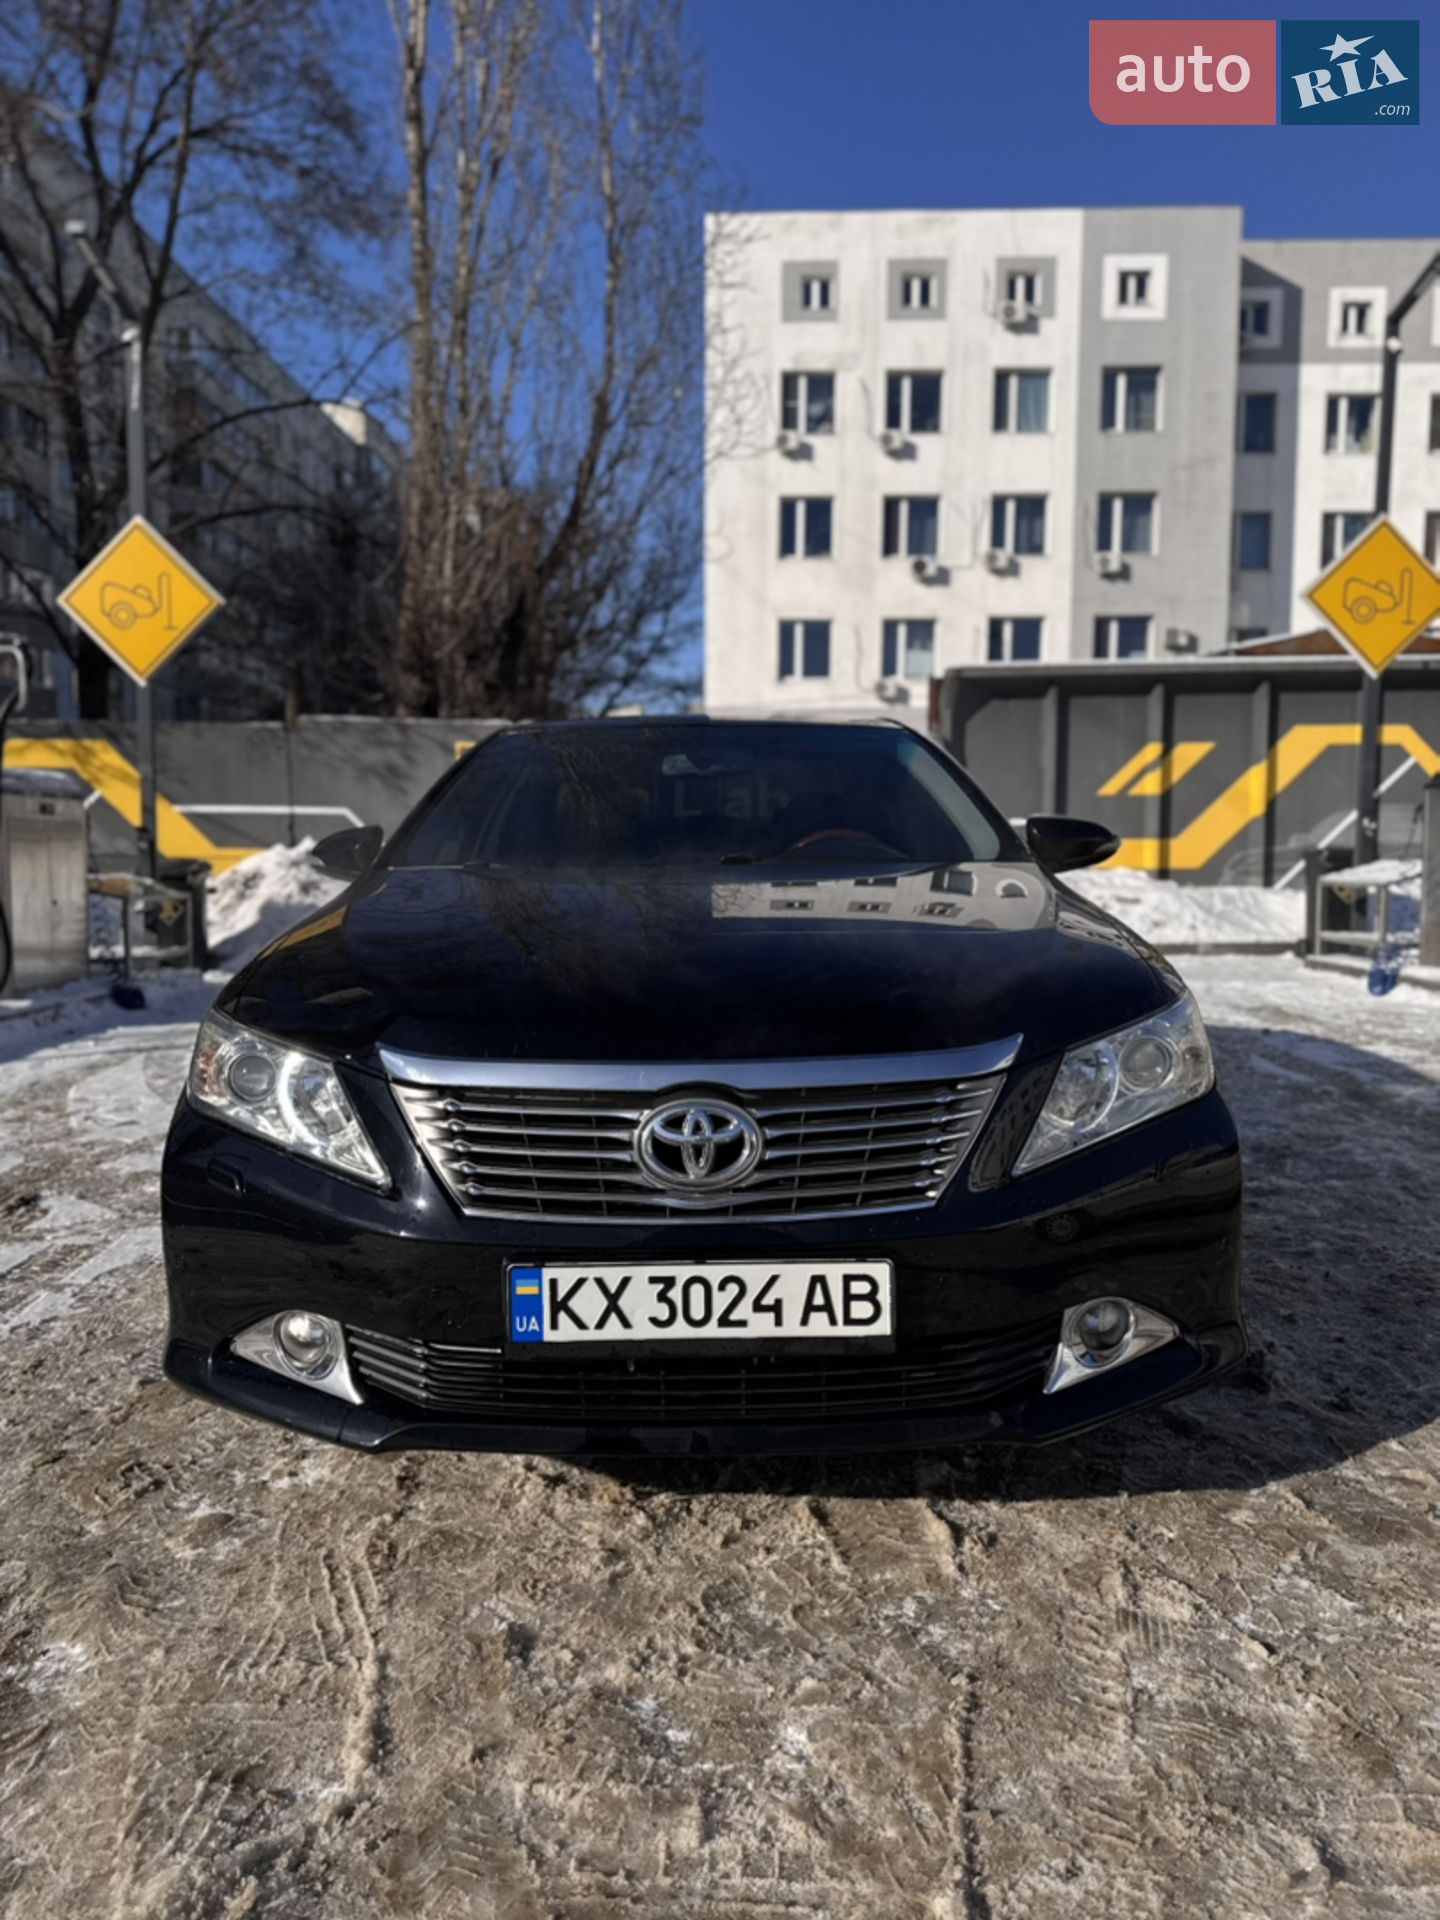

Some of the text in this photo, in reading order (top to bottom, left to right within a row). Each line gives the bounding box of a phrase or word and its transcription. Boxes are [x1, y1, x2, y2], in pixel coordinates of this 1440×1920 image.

[549, 1273, 882, 1330] KX 3024 AB
[515, 1316, 540, 1332] UA
